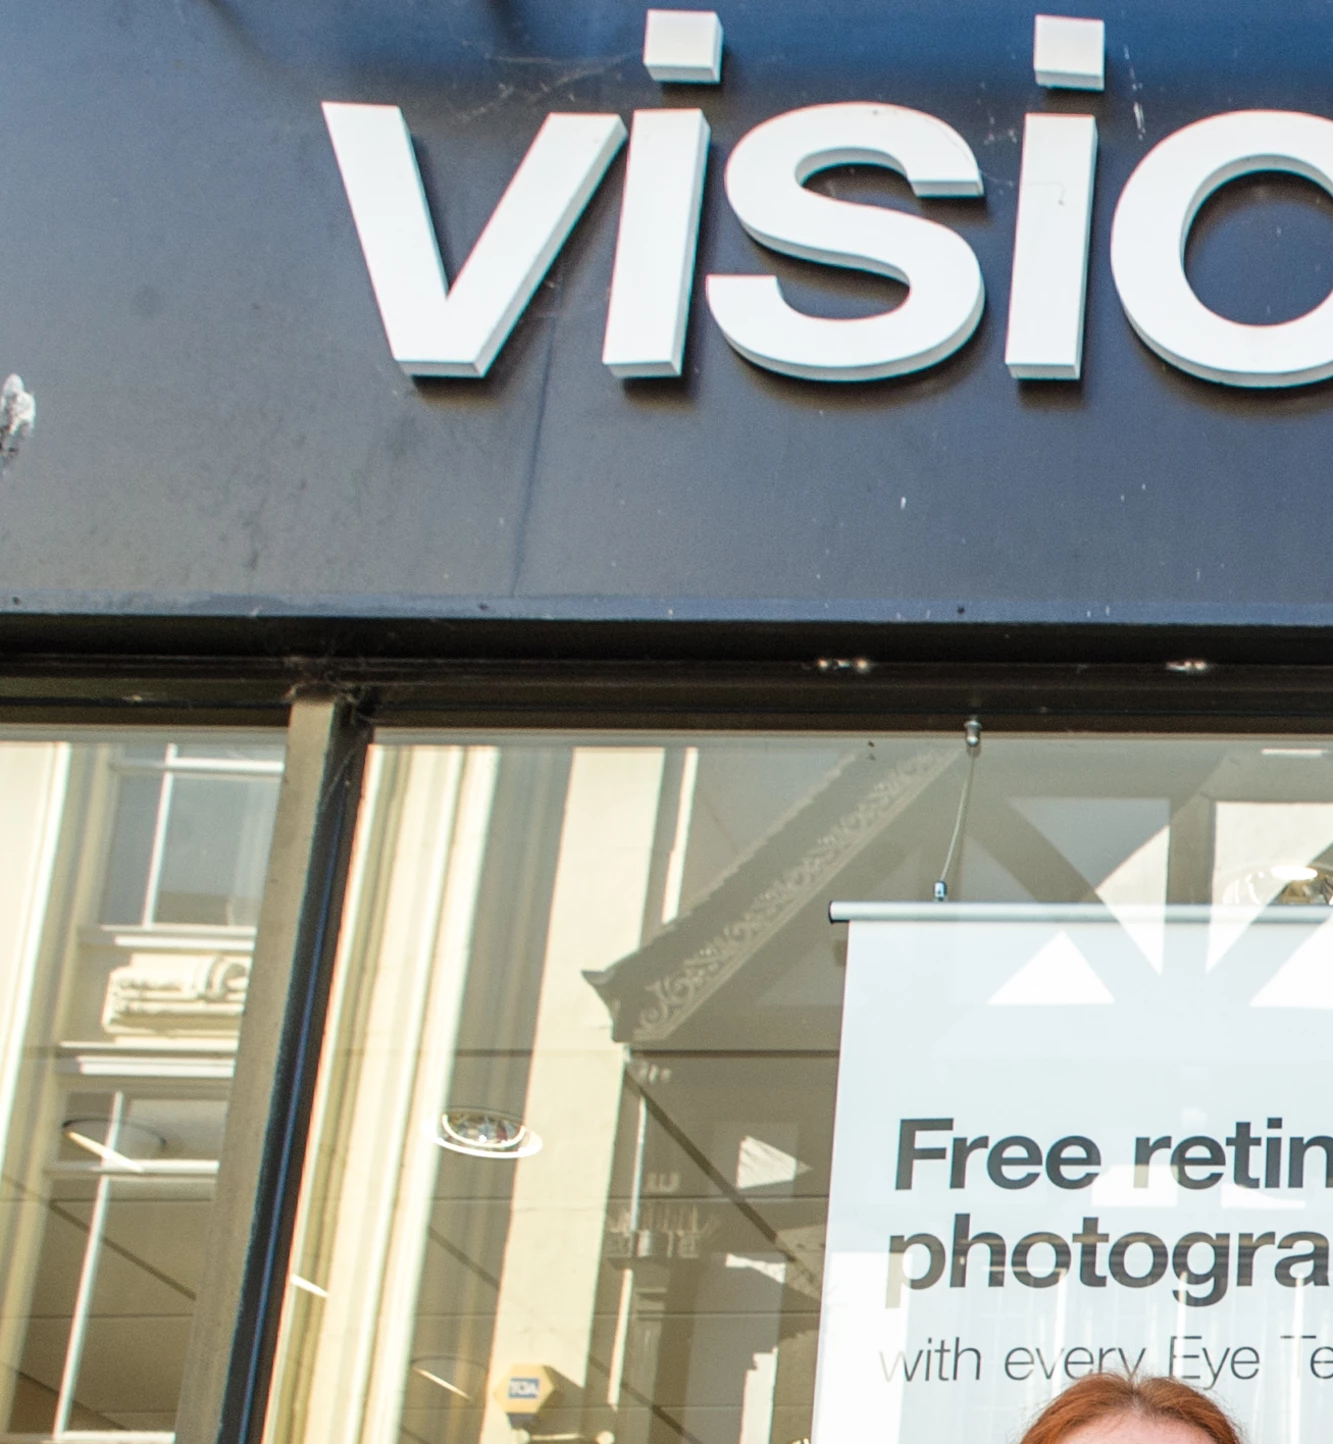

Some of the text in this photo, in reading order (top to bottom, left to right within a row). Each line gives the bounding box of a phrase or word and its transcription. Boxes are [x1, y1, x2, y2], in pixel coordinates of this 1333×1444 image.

[895, 1117, 1102, 1190] Free
[879, 1336, 982, 1382] with
[1003, 1344, 1146, 1379] every
[1168, 1336, 1260, 1391] Eye
